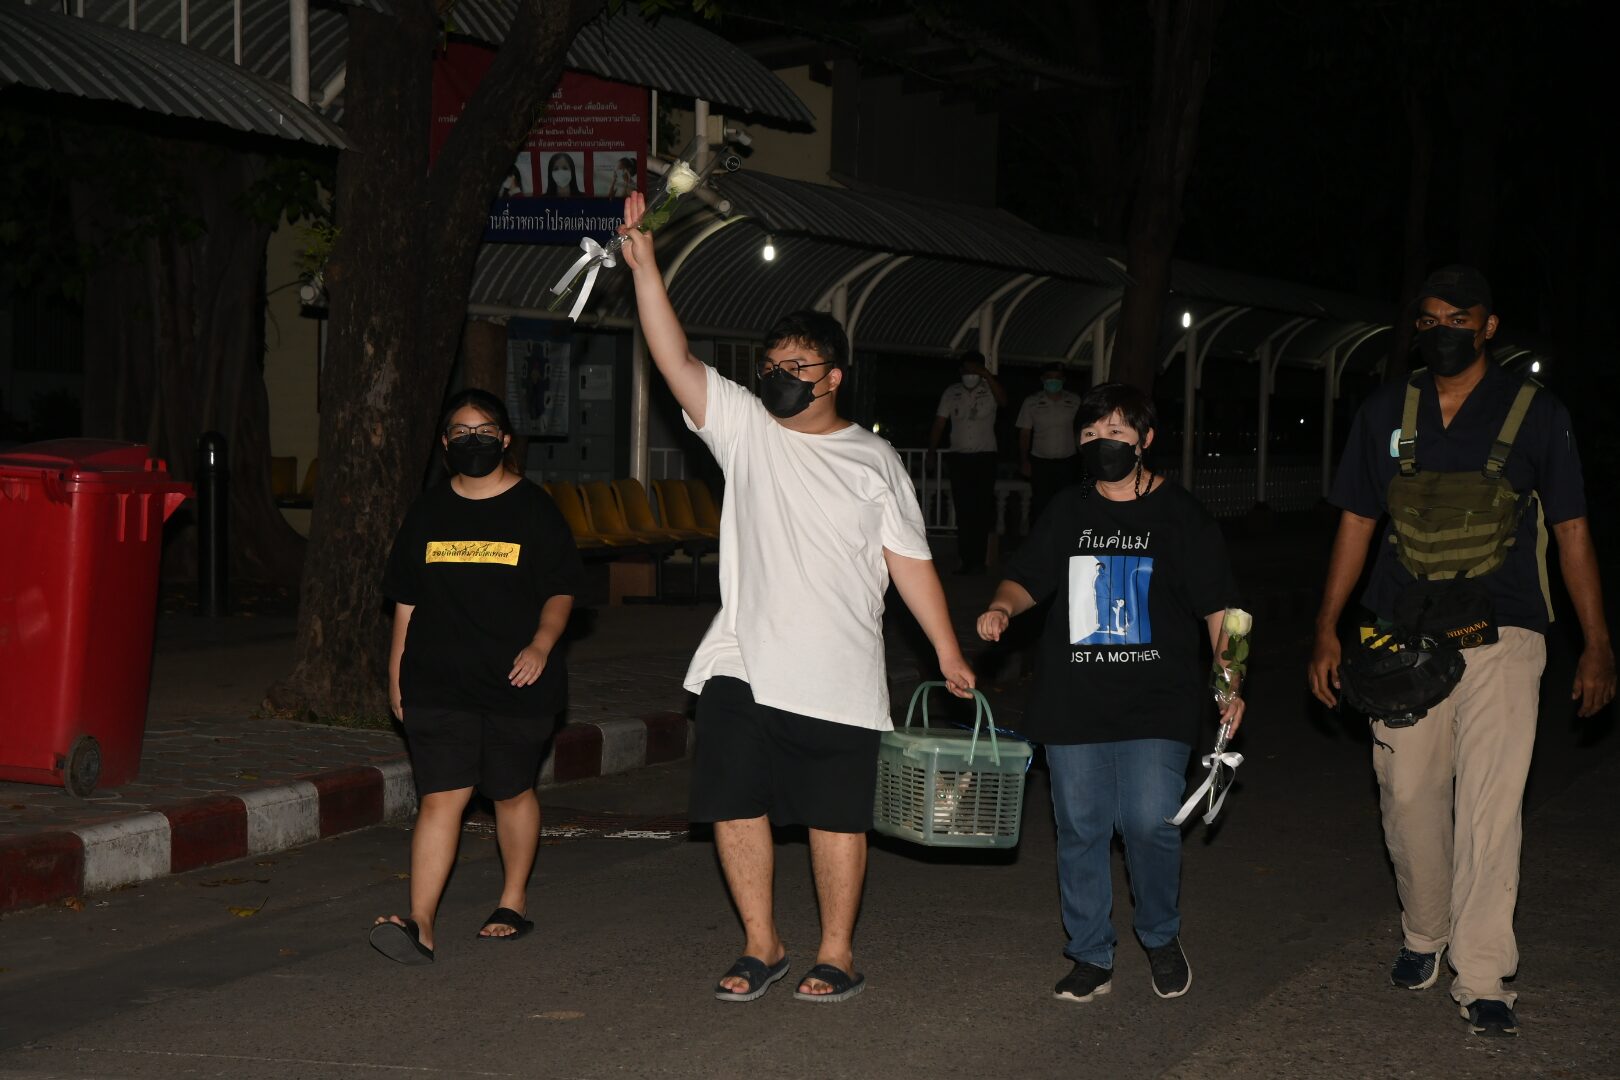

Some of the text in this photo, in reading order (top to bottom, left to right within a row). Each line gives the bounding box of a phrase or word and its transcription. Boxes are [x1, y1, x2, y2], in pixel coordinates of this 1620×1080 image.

[1078, 528, 1150, 550] ก็แค่แม่
[1446, 620, 1489, 638] NIRVANA
[1095, 651, 1105, 663] A
[1108, 649, 1161, 663] MOTHER
